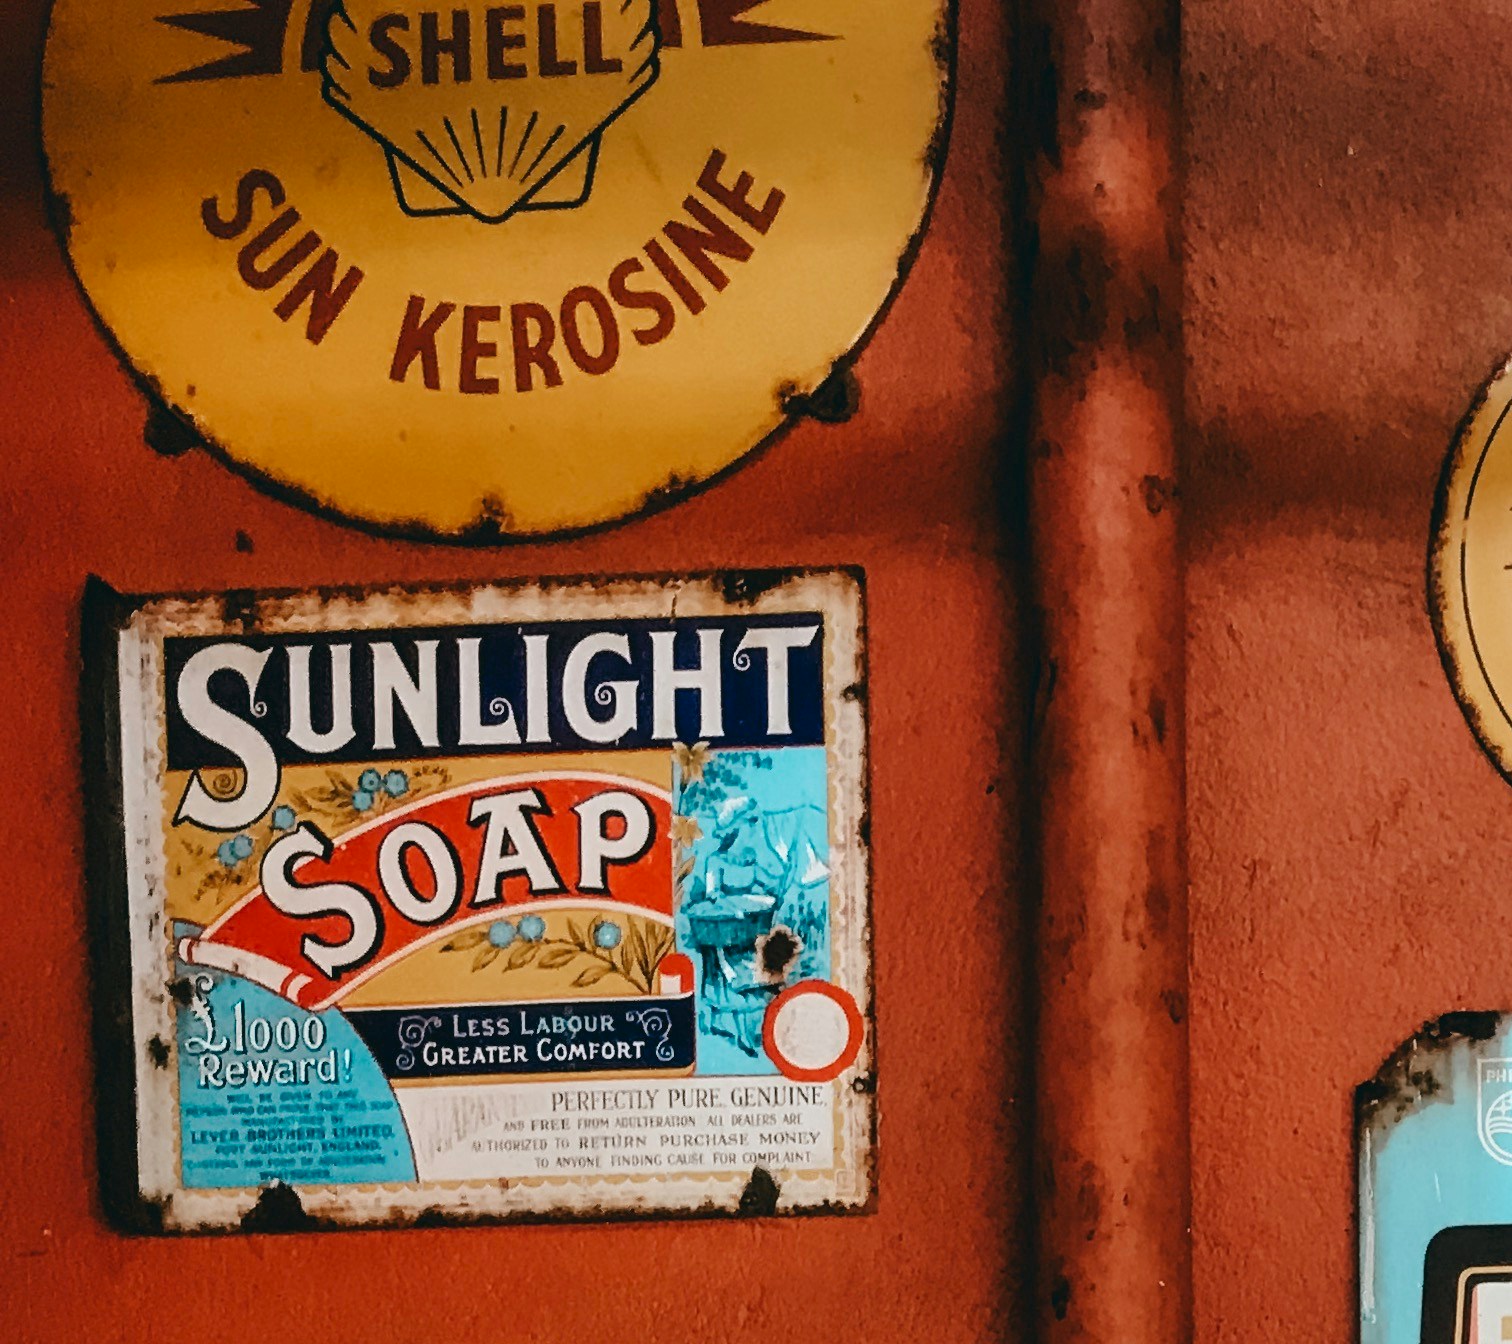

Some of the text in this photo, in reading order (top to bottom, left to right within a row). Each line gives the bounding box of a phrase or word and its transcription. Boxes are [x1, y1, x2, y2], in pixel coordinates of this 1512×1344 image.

[368, 1, 623, 88] SHELL
[201, 148, 786, 395] SUN KEROSINE
[171, 622, 820, 830] SUNLIGHT
[259, 787, 653, 978] SOAP
[198, 1048, 354, 1089] Reward!
[551, 1089, 660, 1112] PERFECTLY
[531, 1118, 571, 1131] FREE
[577, 1116, 609, 1130] FROM
[731, 1113, 777, 1127] DEALERS
[782, 1112, 804, 1126] ARE
[554, 1136, 571, 1150] TO
[579, 1133, 647, 1150] RETURN
[660, 1131, 749, 1148] PURCHASE
[759, 1130, 821, 1146] MONEY
[535, 1156, 550, 1169] TO
[556, 1155, 602, 1170] ANYONE
[610, 1153, 663, 1167] FINDING
[712, 1152, 738, 1166] FOR
